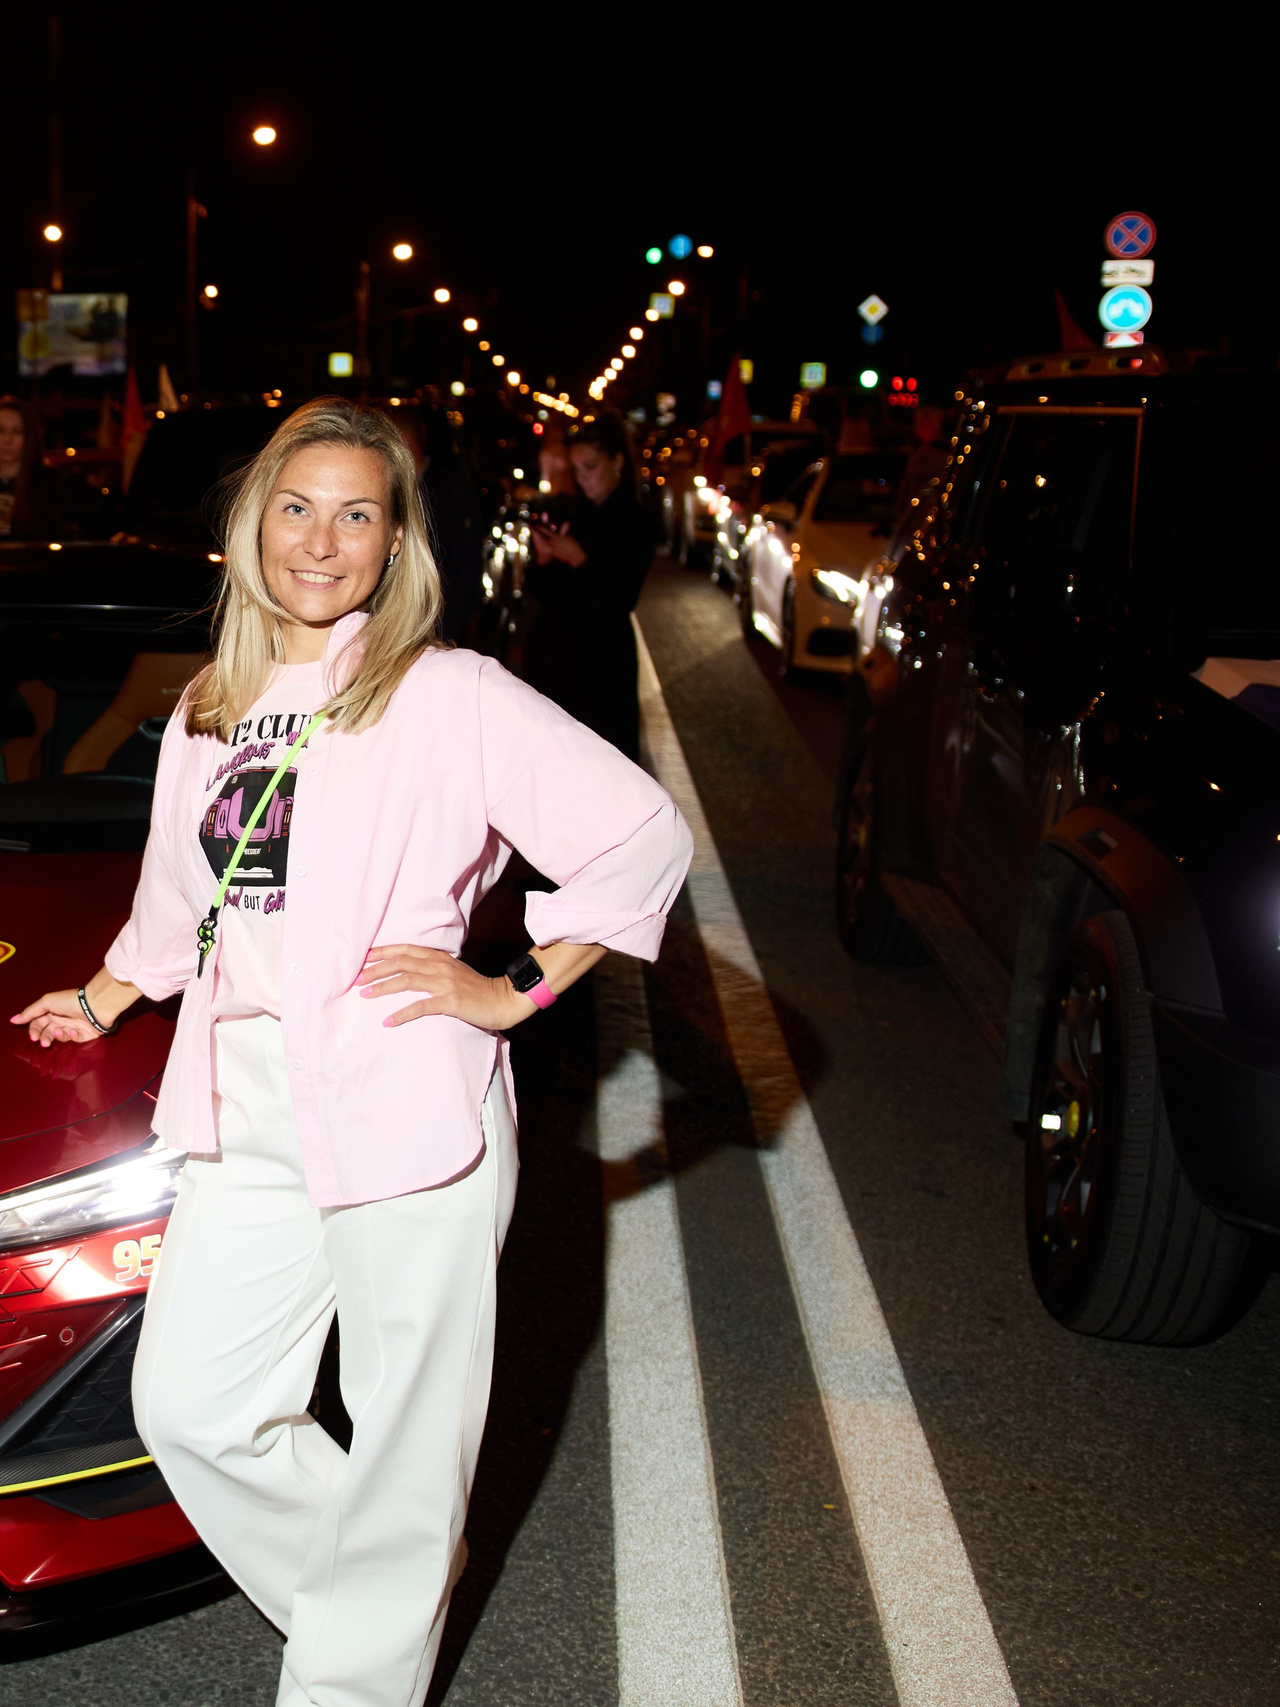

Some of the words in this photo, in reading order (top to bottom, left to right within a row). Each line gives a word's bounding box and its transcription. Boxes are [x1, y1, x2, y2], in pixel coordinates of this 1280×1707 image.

[257, 713, 312, 740] CLU
[206, 741, 276, 791] LAMOROUS
[244, 894, 261, 910] BUT
[113, 1234, 162, 1283] 95
